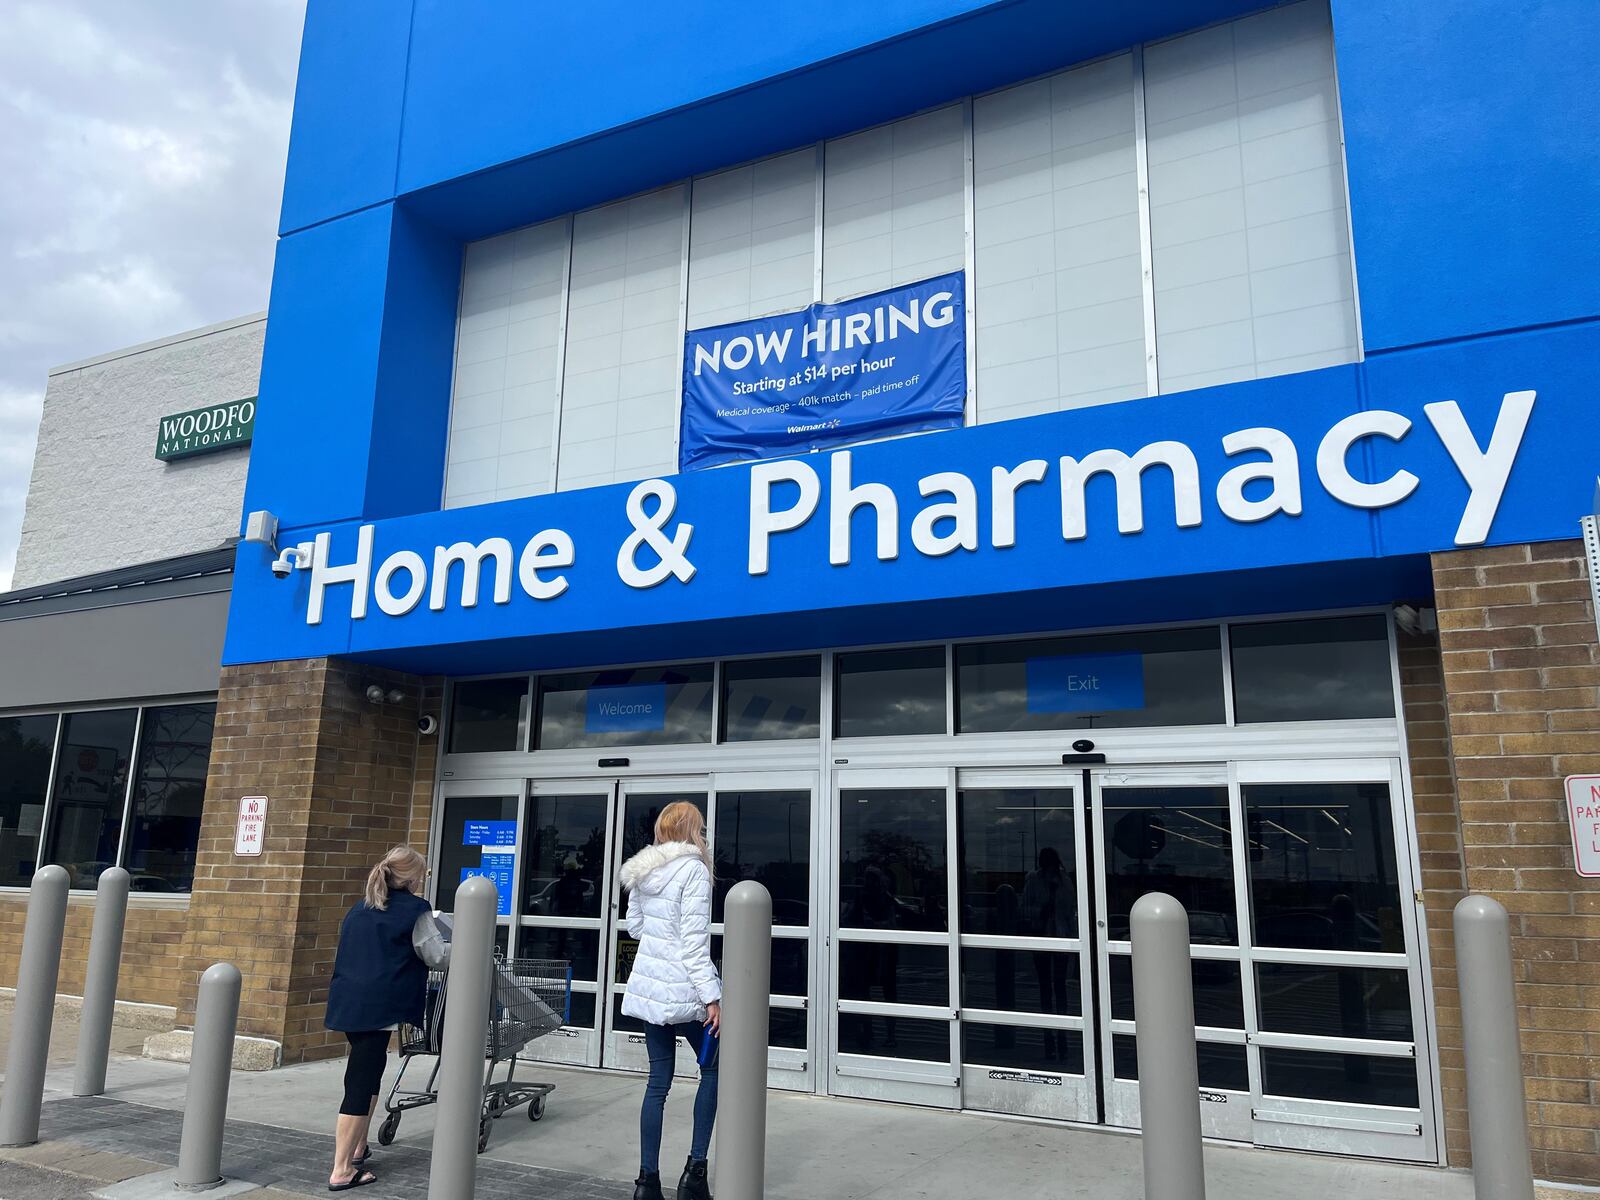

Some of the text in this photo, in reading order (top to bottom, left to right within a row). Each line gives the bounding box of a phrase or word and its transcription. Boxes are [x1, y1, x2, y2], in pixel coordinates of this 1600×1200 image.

[694, 291, 954, 376] NOW HIRING
[733, 356, 896, 396] Starting at $14 per hour
[716, 406, 750, 418] Medical
[751, 402, 790, 415] coverage
[798, 396, 820, 407] 401k
[821, 391, 852, 404] match
[861, 383, 881, 400] paid
[882, 380, 904, 393] time
[905, 374, 920, 387] off
[787, 421, 827, 434] Walmart
[161, 427, 243, 454] NATIONAL
[306, 389, 1537, 625] Home & Pharmacy
[1067, 674, 1100, 691] Exit
[598, 701, 653, 716] Welcome
[248, 802, 259, 813] NO
[242, 814, 263, 822] PARKING
[245, 824, 257, 832] FIRE
[243, 834, 257, 842] LANE
